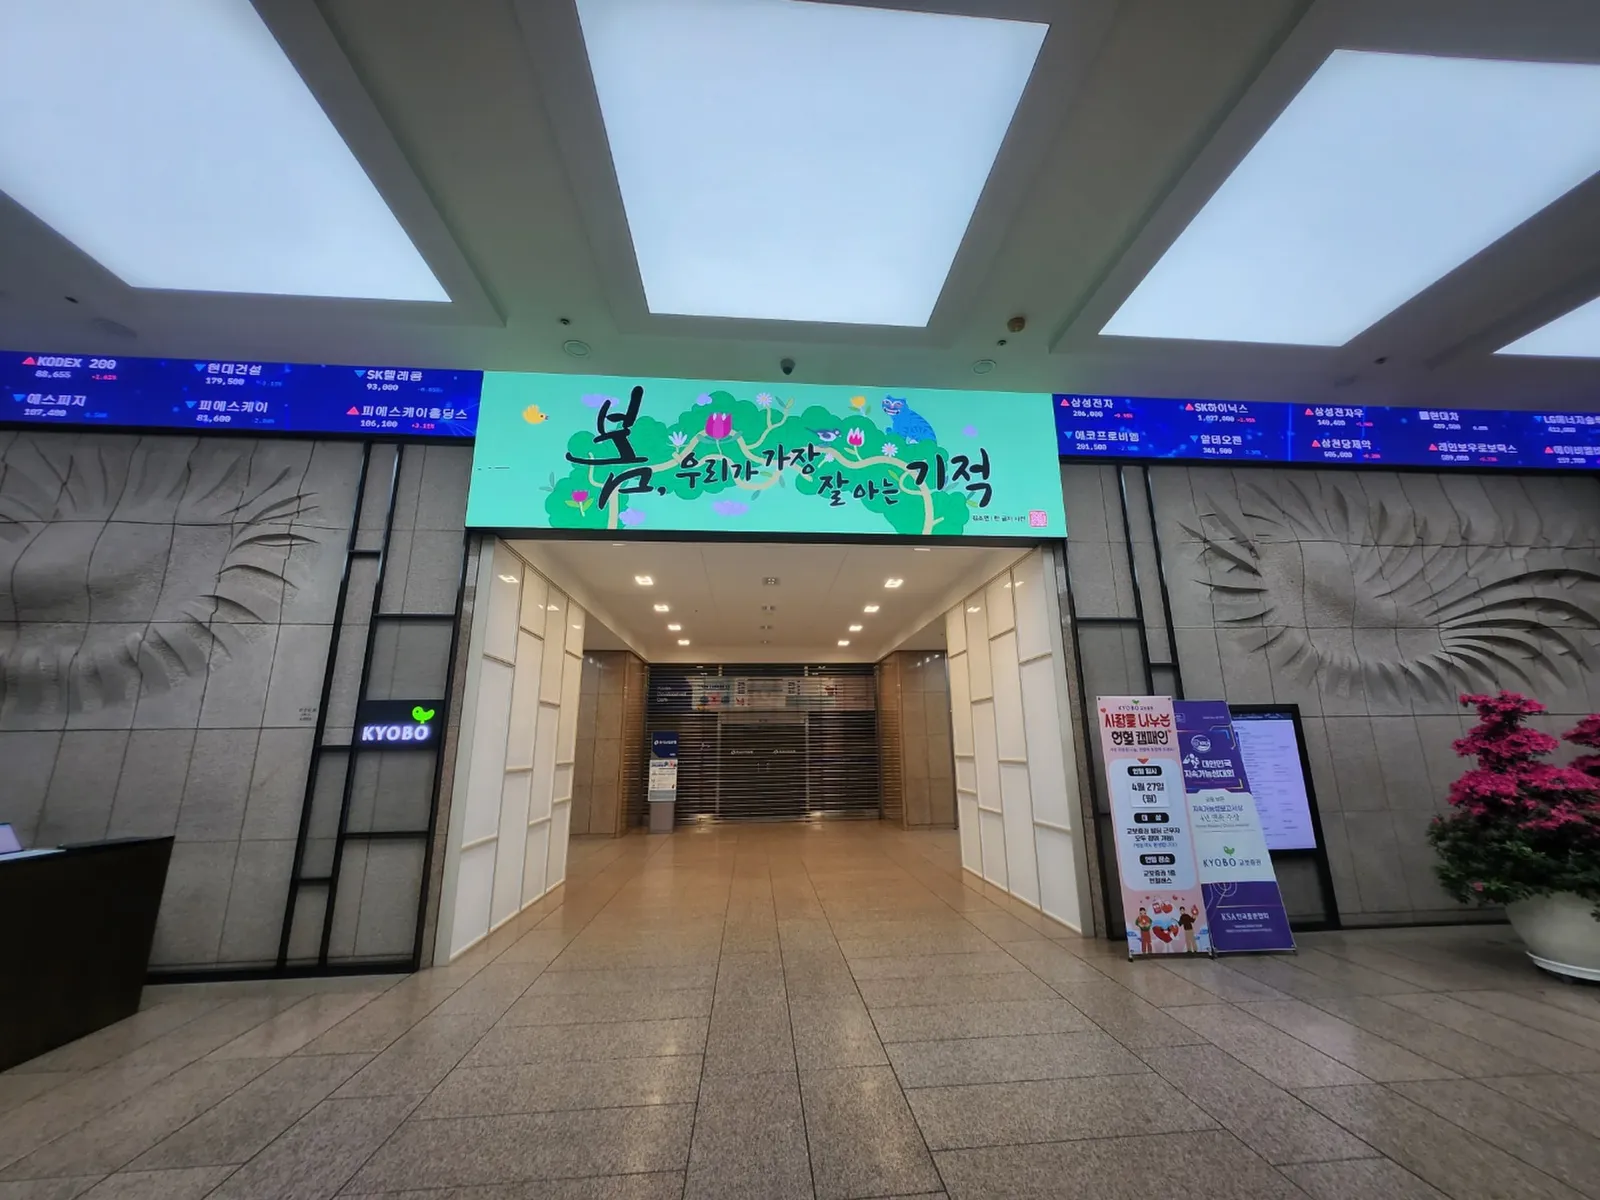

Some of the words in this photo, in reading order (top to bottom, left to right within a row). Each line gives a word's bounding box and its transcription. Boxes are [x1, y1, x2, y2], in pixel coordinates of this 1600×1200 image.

[37, 356, 82, 368] KODEX
[89, 359, 117, 369] 200
[35, 370, 71, 379] 88,655
[207, 363, 262, 376] 현대건설
[367, 369, 423, 382] SK텔레콤
[205, 377, 245, 386] 179,500
[198, 400, 268, 413] 피에스케이
[1071, 398, 1113, 409] 삼성전자
[1194, 403, 1249, 413] SK하이닉스
[361, 405, 468, 420] 피에스케이홀딩스
[1315, 407, 1364, 418] 삼성전자우
[1075, 430, 1140, 442] 에코프로비엠
[1200, 434, 1242, 446] 알테오젠
[565, 385, 667, 510] 봄,
[675, 451, 759, 489] 우리가
[762, 444, 821, 475] 가장
[817, 471, 849, 507] 잘
[853, 478, 899, 505] 아는
[905, 447, 993, 508] 기적
[1321, 439, 1371, 449] 삼천당제약
[1104, 713, 1137, 728] 사랑을
[1138, 713, 1171, 728] 나누는
[362, 725, 429, 741] KYOBO
[1111, 730, 1135, 746] 헌혈
[1135, 730, 1169, 746] 캠페인
[1201, 759, 1232, 768] 대한민국
[1131, 783, 1146, 791] 4월
[1146, 782, 1164, 791] 27일
[1203, 857, 1237, 867] KYOBO
